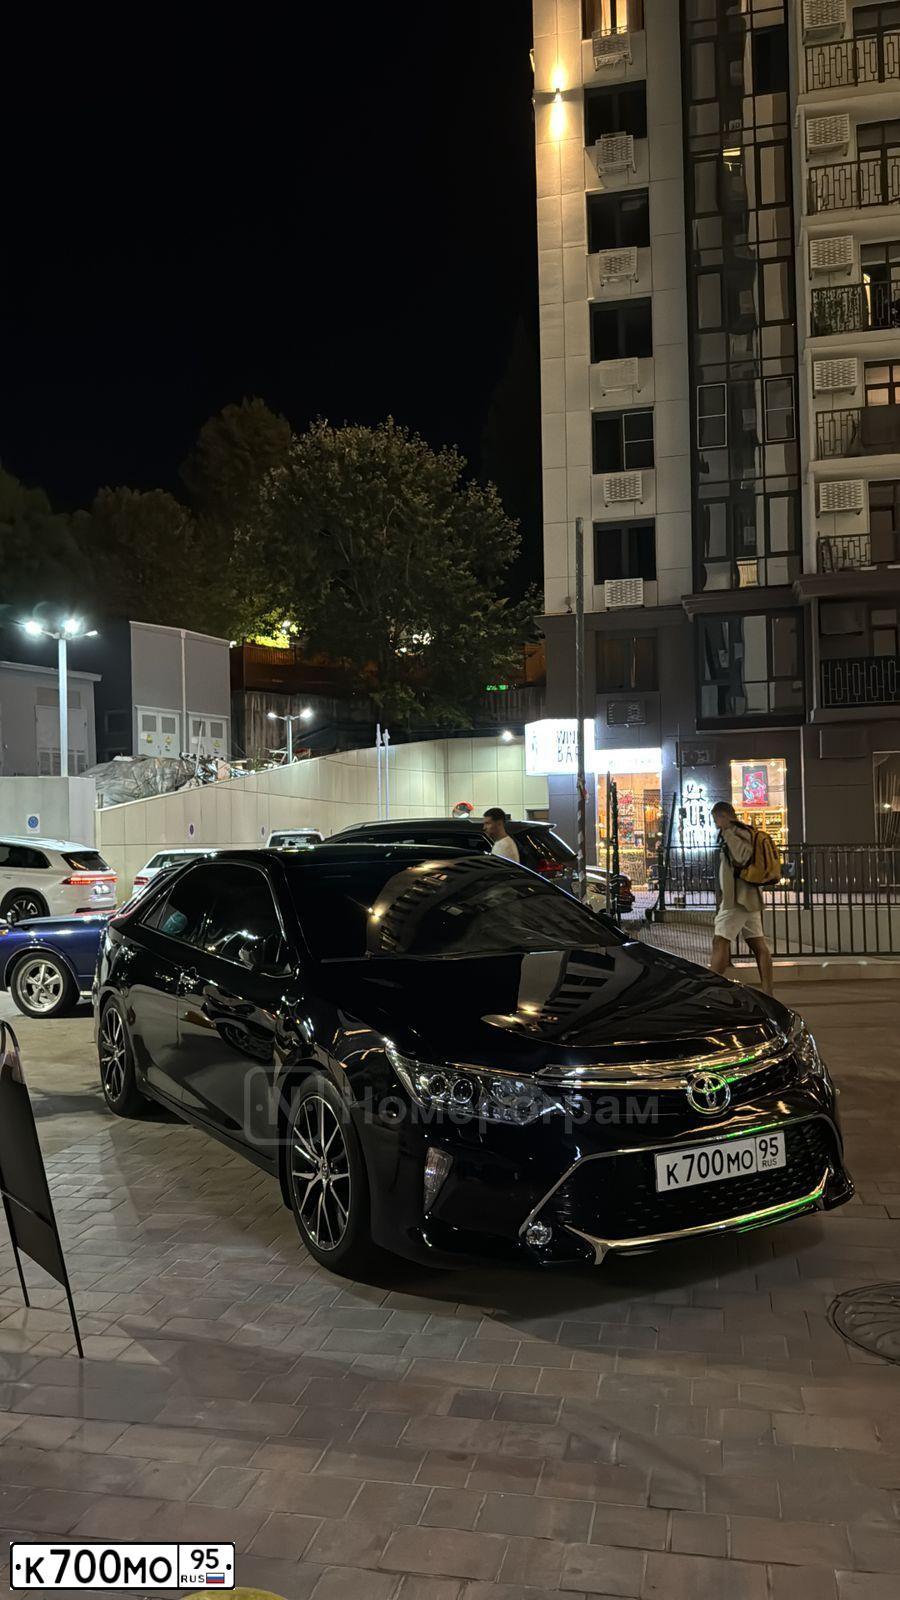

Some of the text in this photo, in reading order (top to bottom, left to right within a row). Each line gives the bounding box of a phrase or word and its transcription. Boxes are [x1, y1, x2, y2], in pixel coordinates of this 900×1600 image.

[556, 730, 577, 744] WIN
[666, 1137, 779, 1186] К700МО 95
[762, 1159, 778, 1168] RUS
